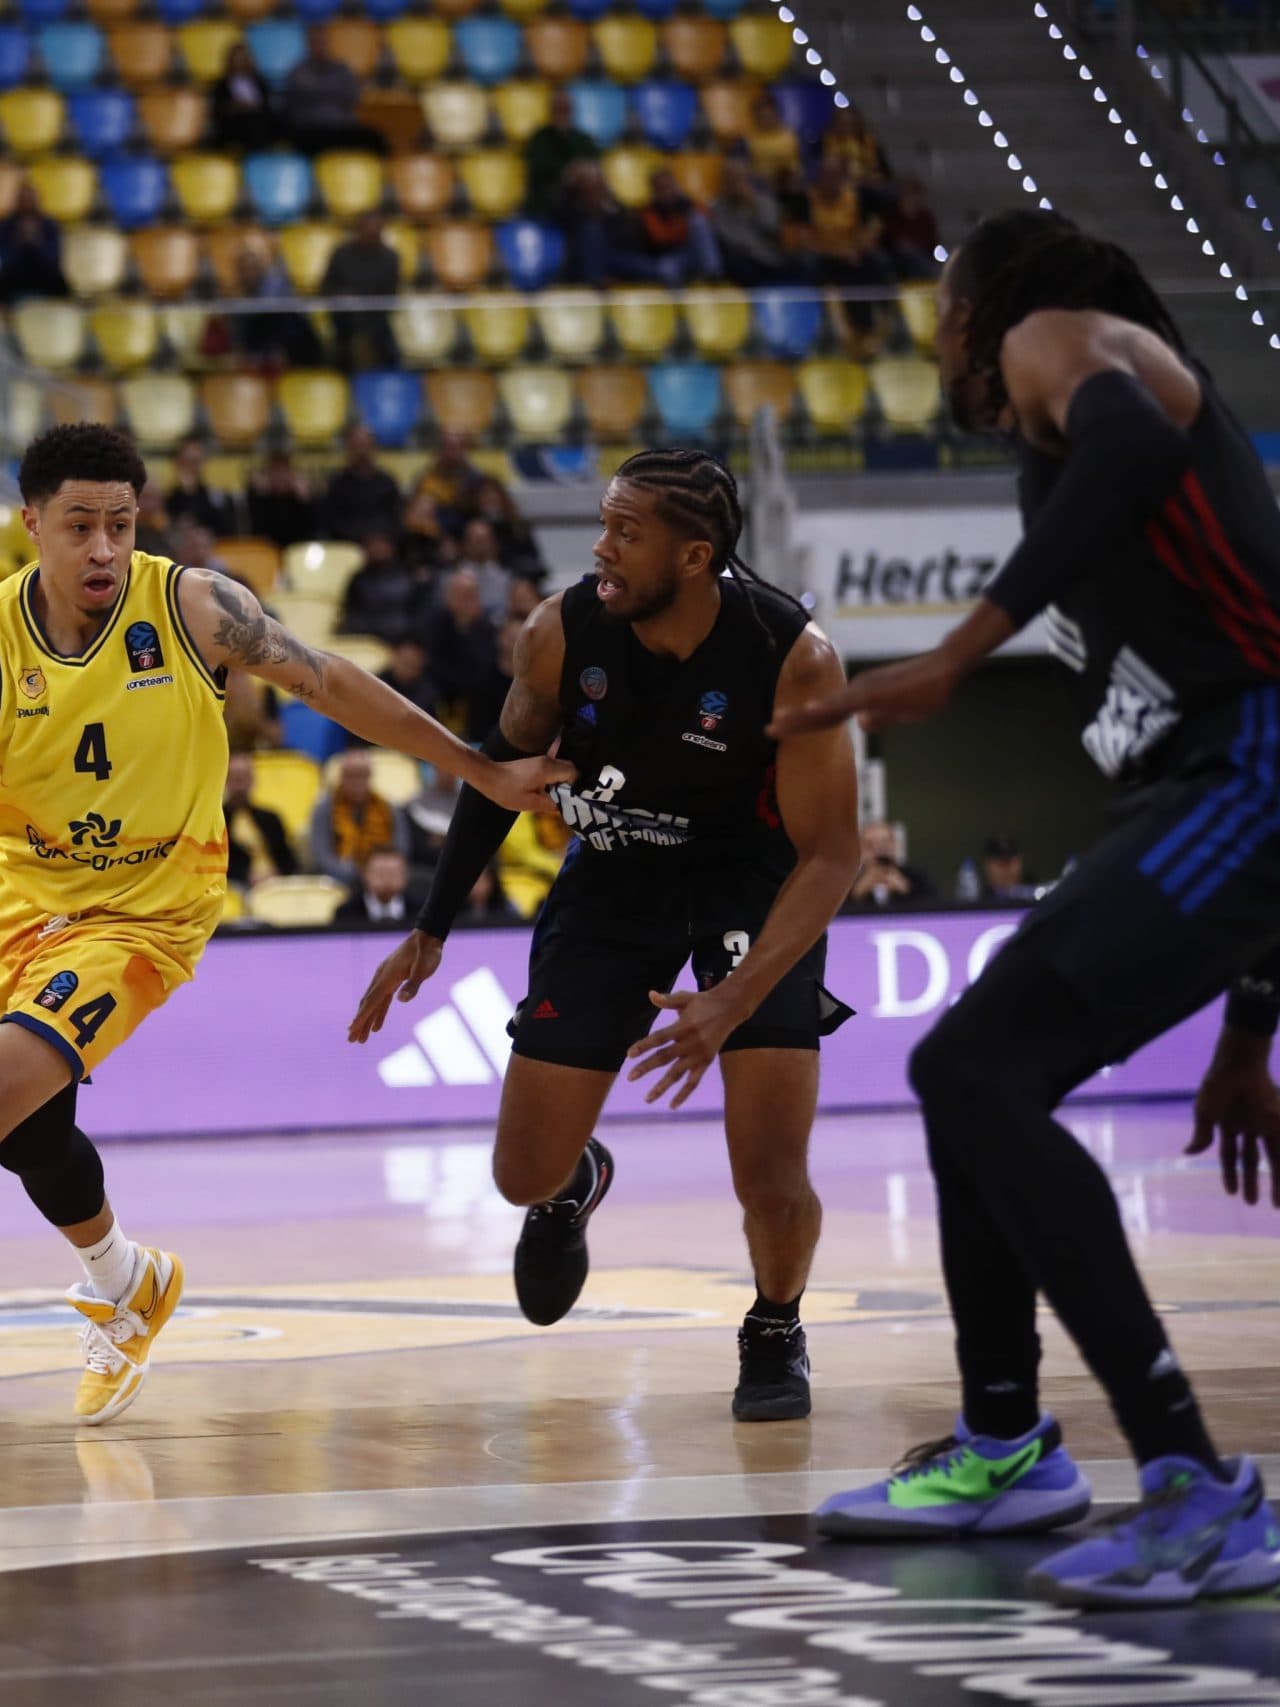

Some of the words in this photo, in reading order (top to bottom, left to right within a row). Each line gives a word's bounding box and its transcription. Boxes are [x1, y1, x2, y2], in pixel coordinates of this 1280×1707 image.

[835, 548, 997, 601] Hertz
[74, 722, 112, 781] 4
[69, 992, 117, 1050] 4
